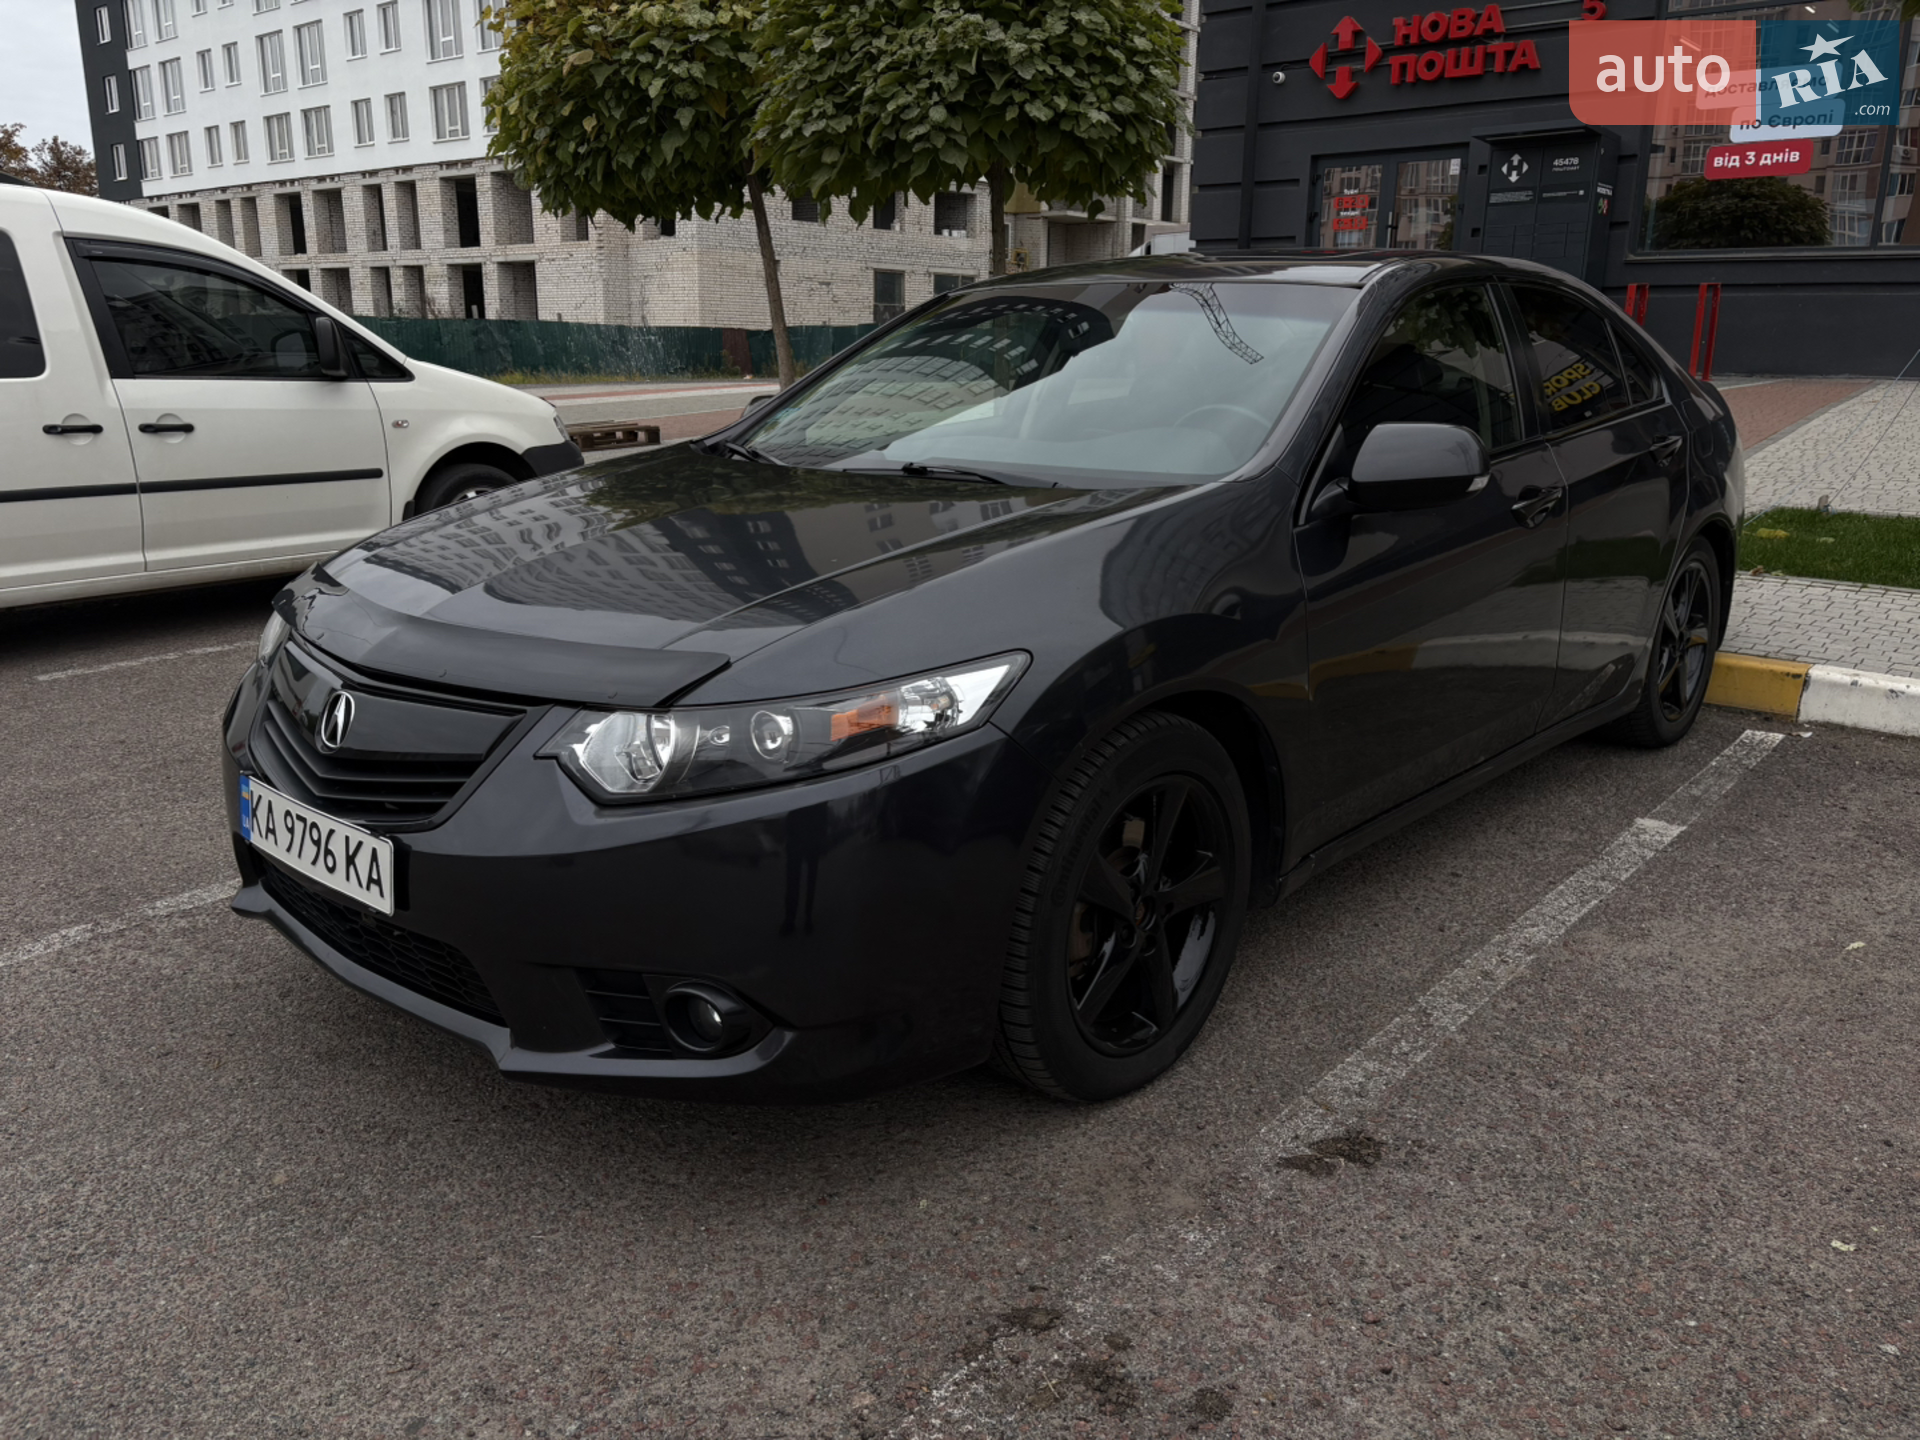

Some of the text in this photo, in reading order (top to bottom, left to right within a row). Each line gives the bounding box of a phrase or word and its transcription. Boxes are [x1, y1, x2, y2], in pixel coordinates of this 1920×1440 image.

[1392, 3, 1506, 46] НОВА
[1389, 39, 1541, 85] ПОШТА
[1740, 109, 1834, 130] по Європі
[1713, 149, 1801, 169] від 3 днів
[250, 789, 385, 899] KA 9796 KA
